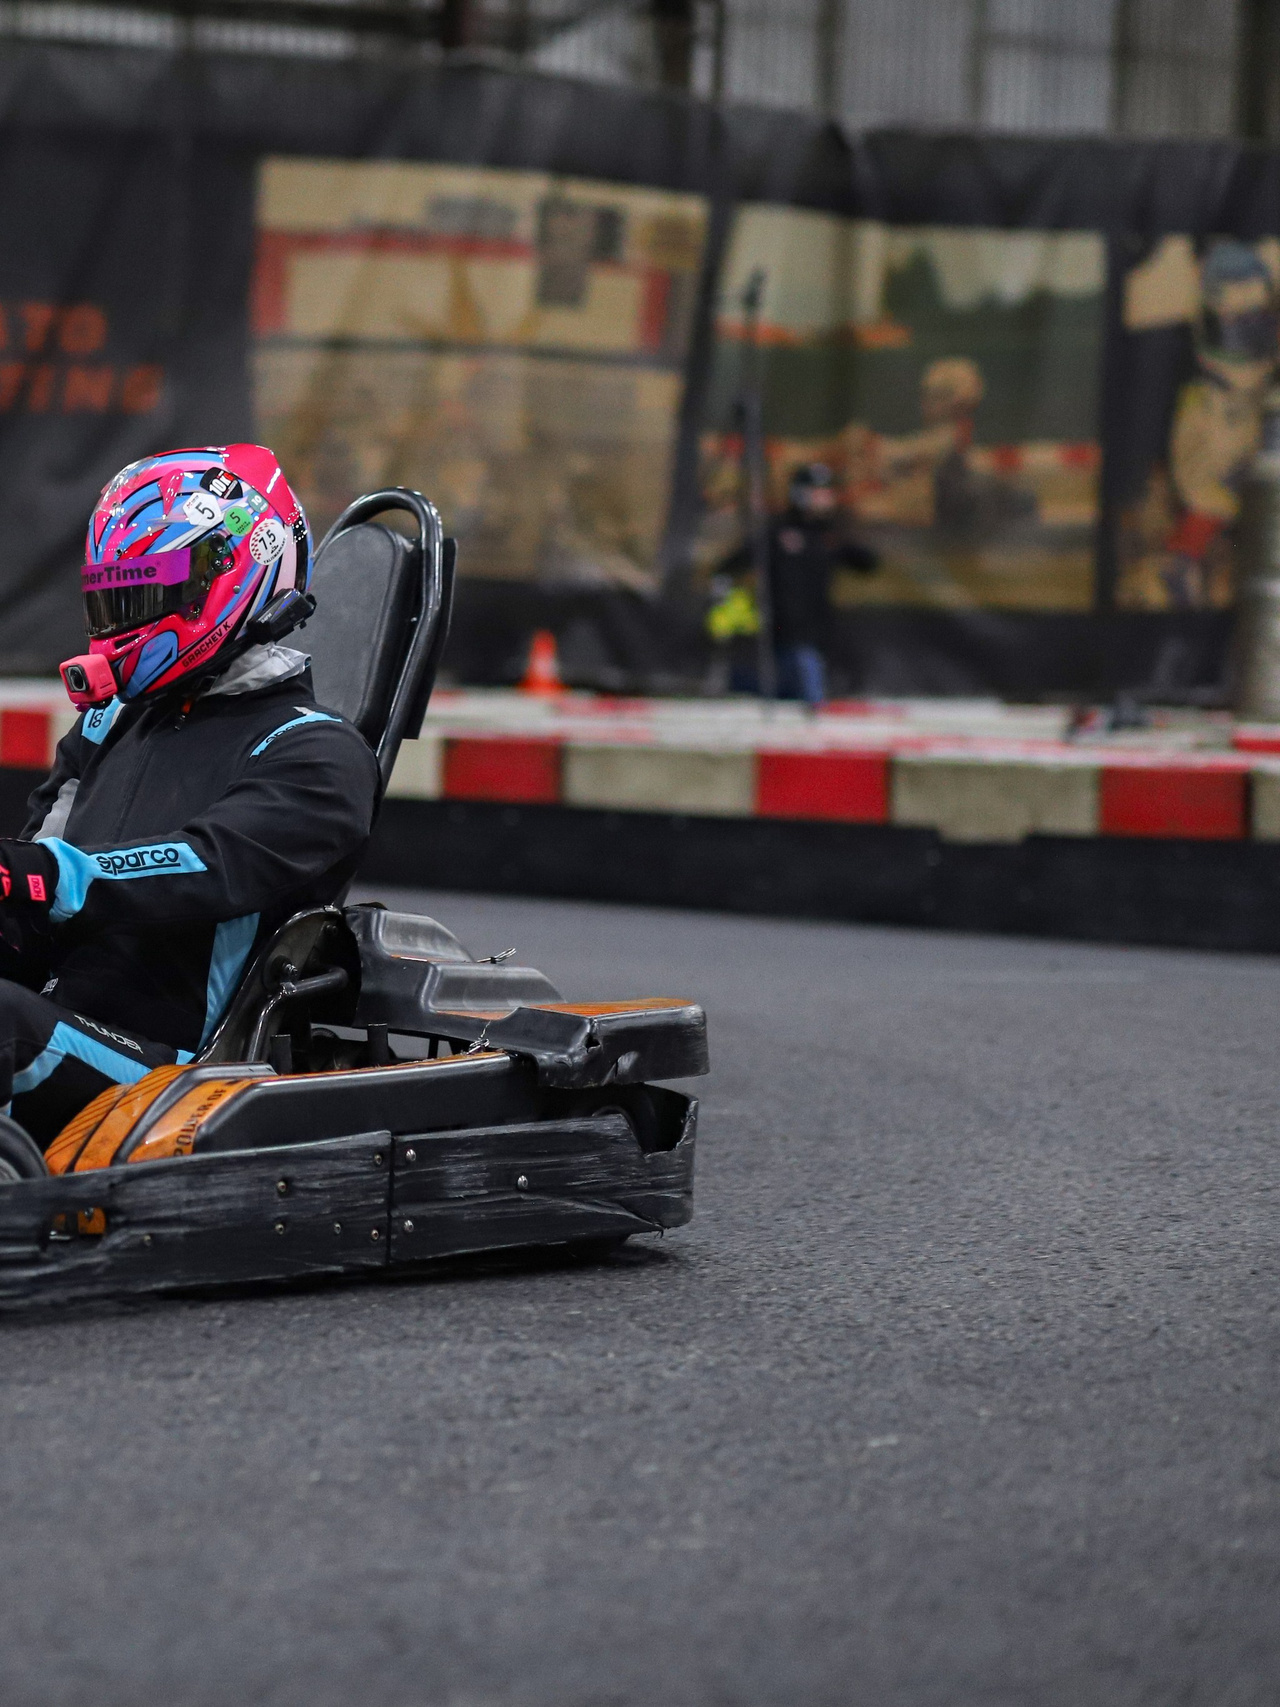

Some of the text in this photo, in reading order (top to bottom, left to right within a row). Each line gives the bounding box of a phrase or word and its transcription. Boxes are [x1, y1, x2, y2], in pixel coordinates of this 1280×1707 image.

[195, 501, 215, 520] 5
[229, 511, 240, 524] 5
[258, 529, 276, 551] 7.5
[181, 627, 224, 668] GRACHEV
[95, 847, 181, 876] sparco
